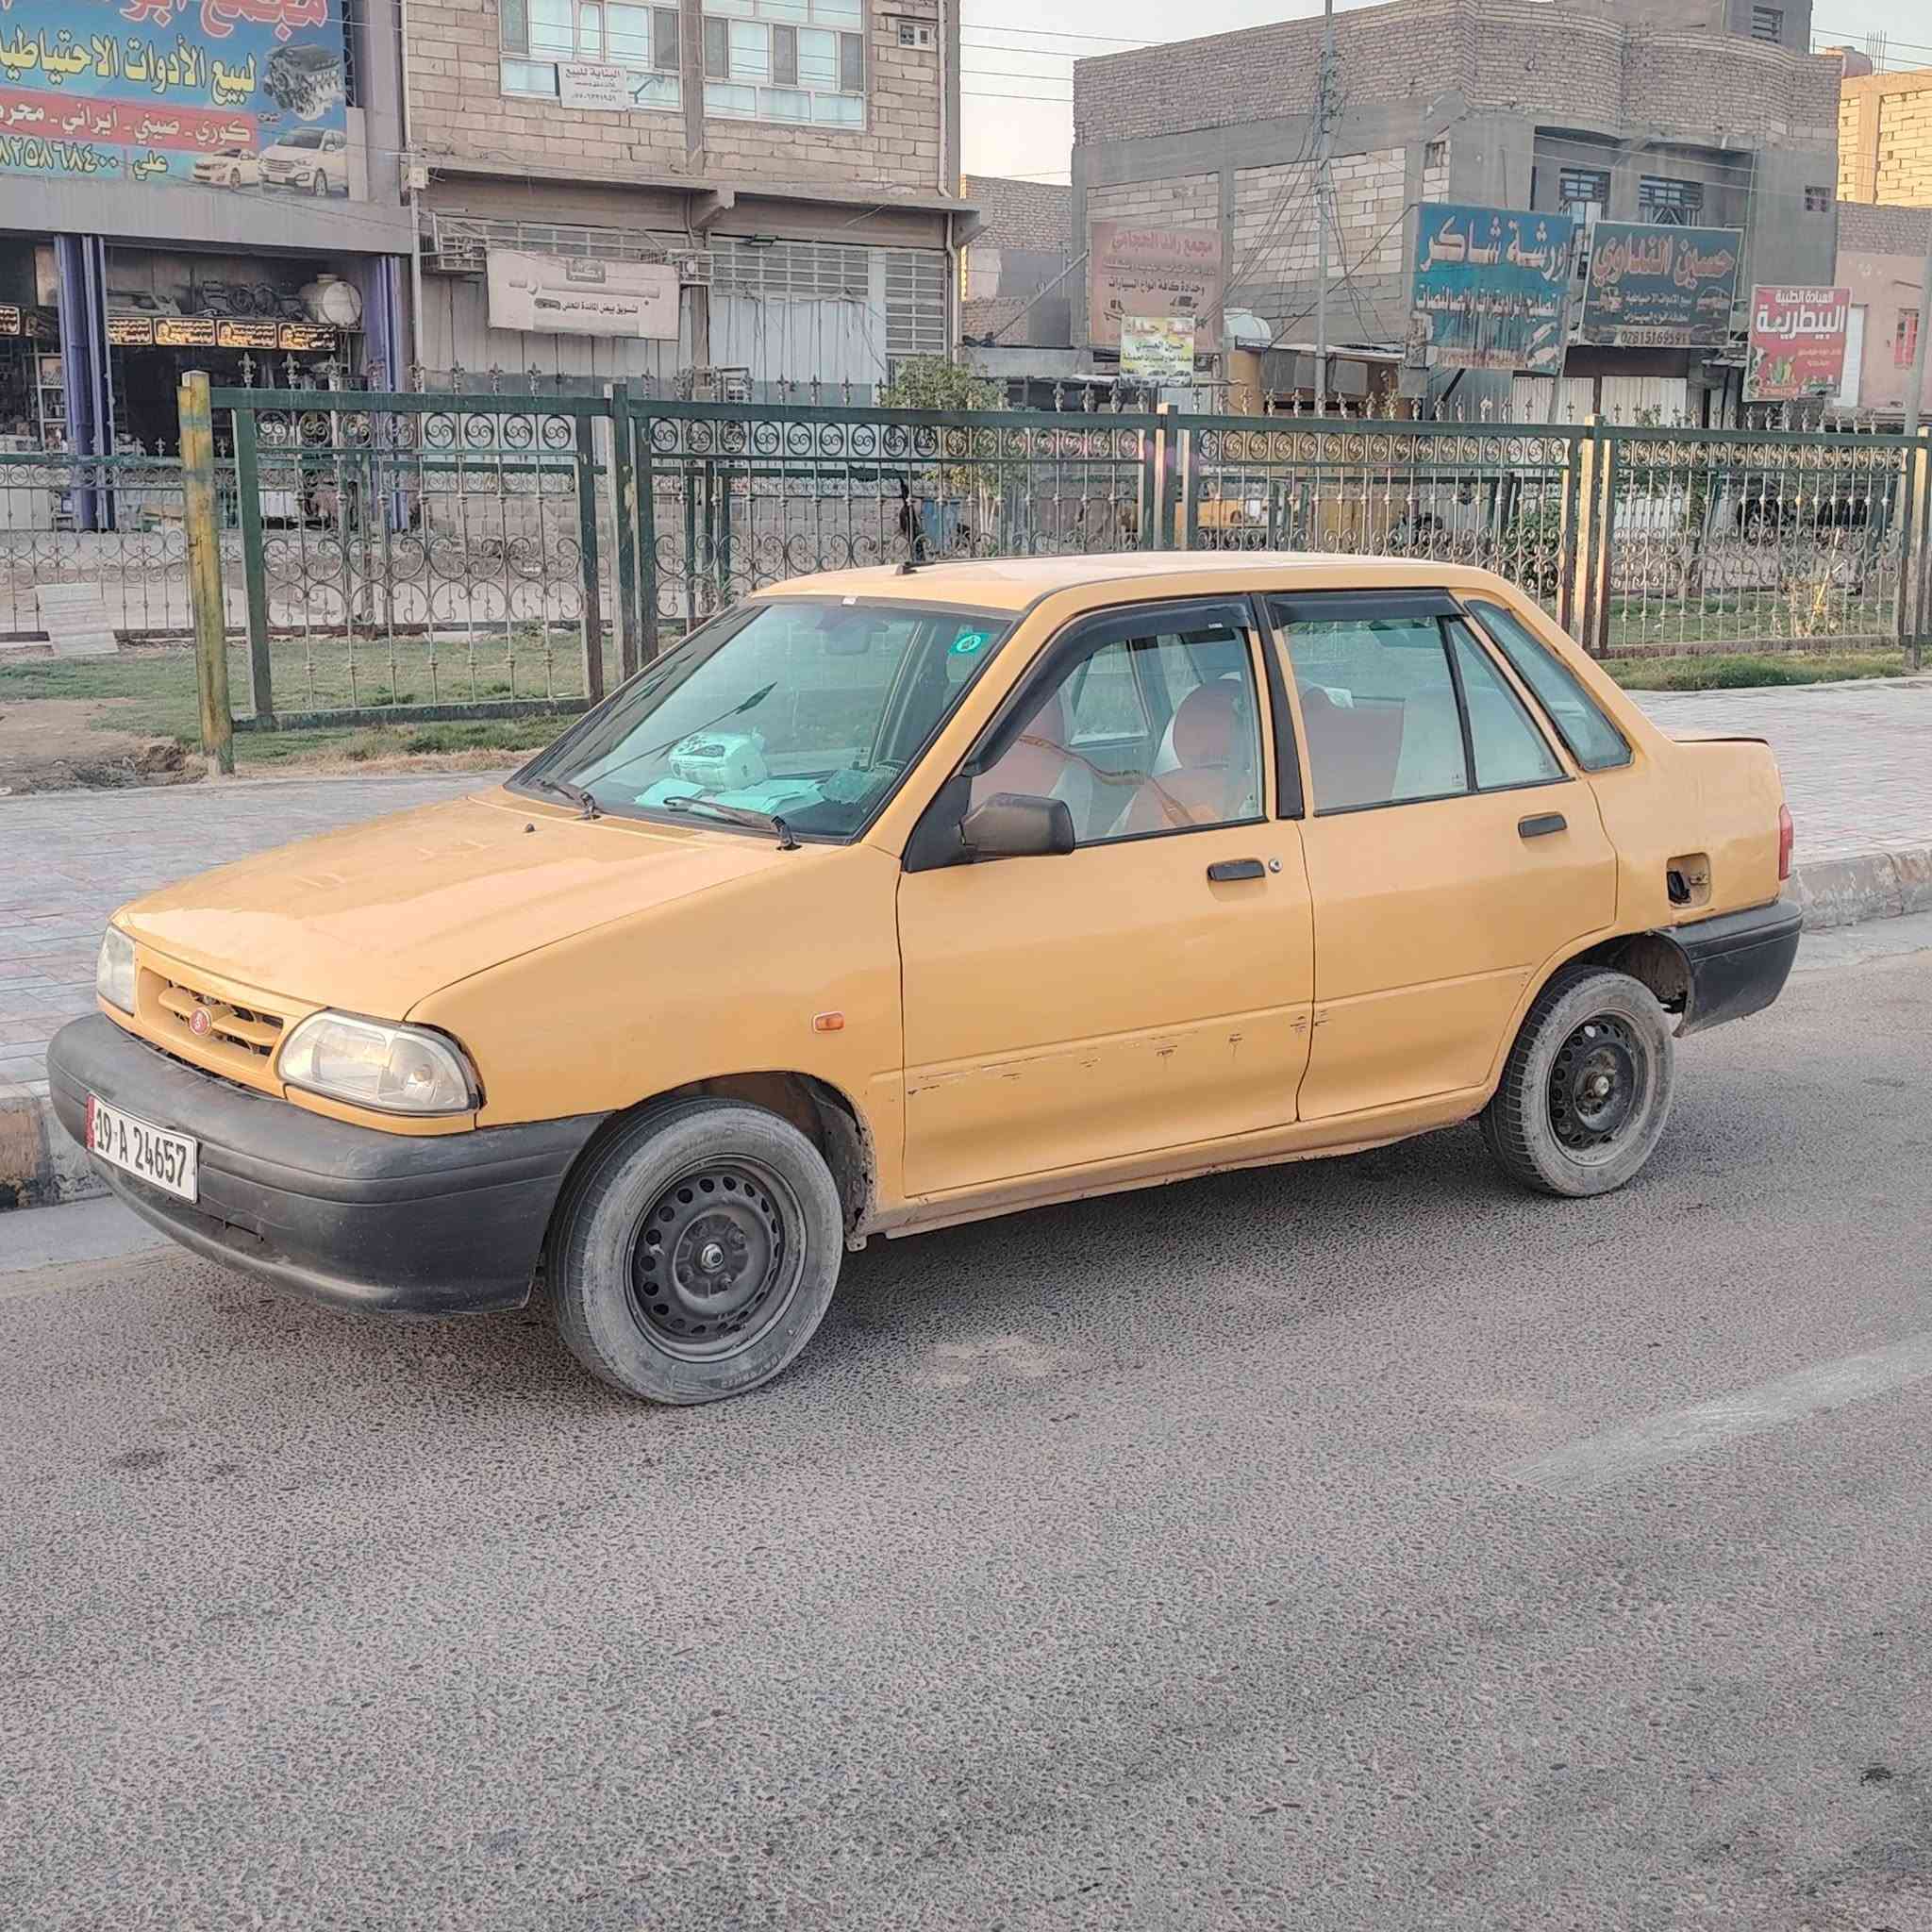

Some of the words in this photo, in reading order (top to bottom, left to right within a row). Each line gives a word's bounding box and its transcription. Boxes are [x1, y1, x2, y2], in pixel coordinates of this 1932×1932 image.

[0, 24, 120, 85] الاحتياطي
[211, 52, 257, 106] لبيع
[135, 113, 180, 144] صيني
[195, 120, 250, 145] كوري
[133, 150, 169, 180] علي
[1420, 214, 1502, 273] شاكر
[1507, 219, 1569, 282] ورشة
[1674, 238, 1737, 291] حسين
[1775, 289, 1805, 306] الطبية
[1806, 290, 1835, 307] العيادة
[1757, 304, 1846, 340] البيطرية
[118, 1119, 128, 1163] A
[133, 1125, 187, 1188] 24657
